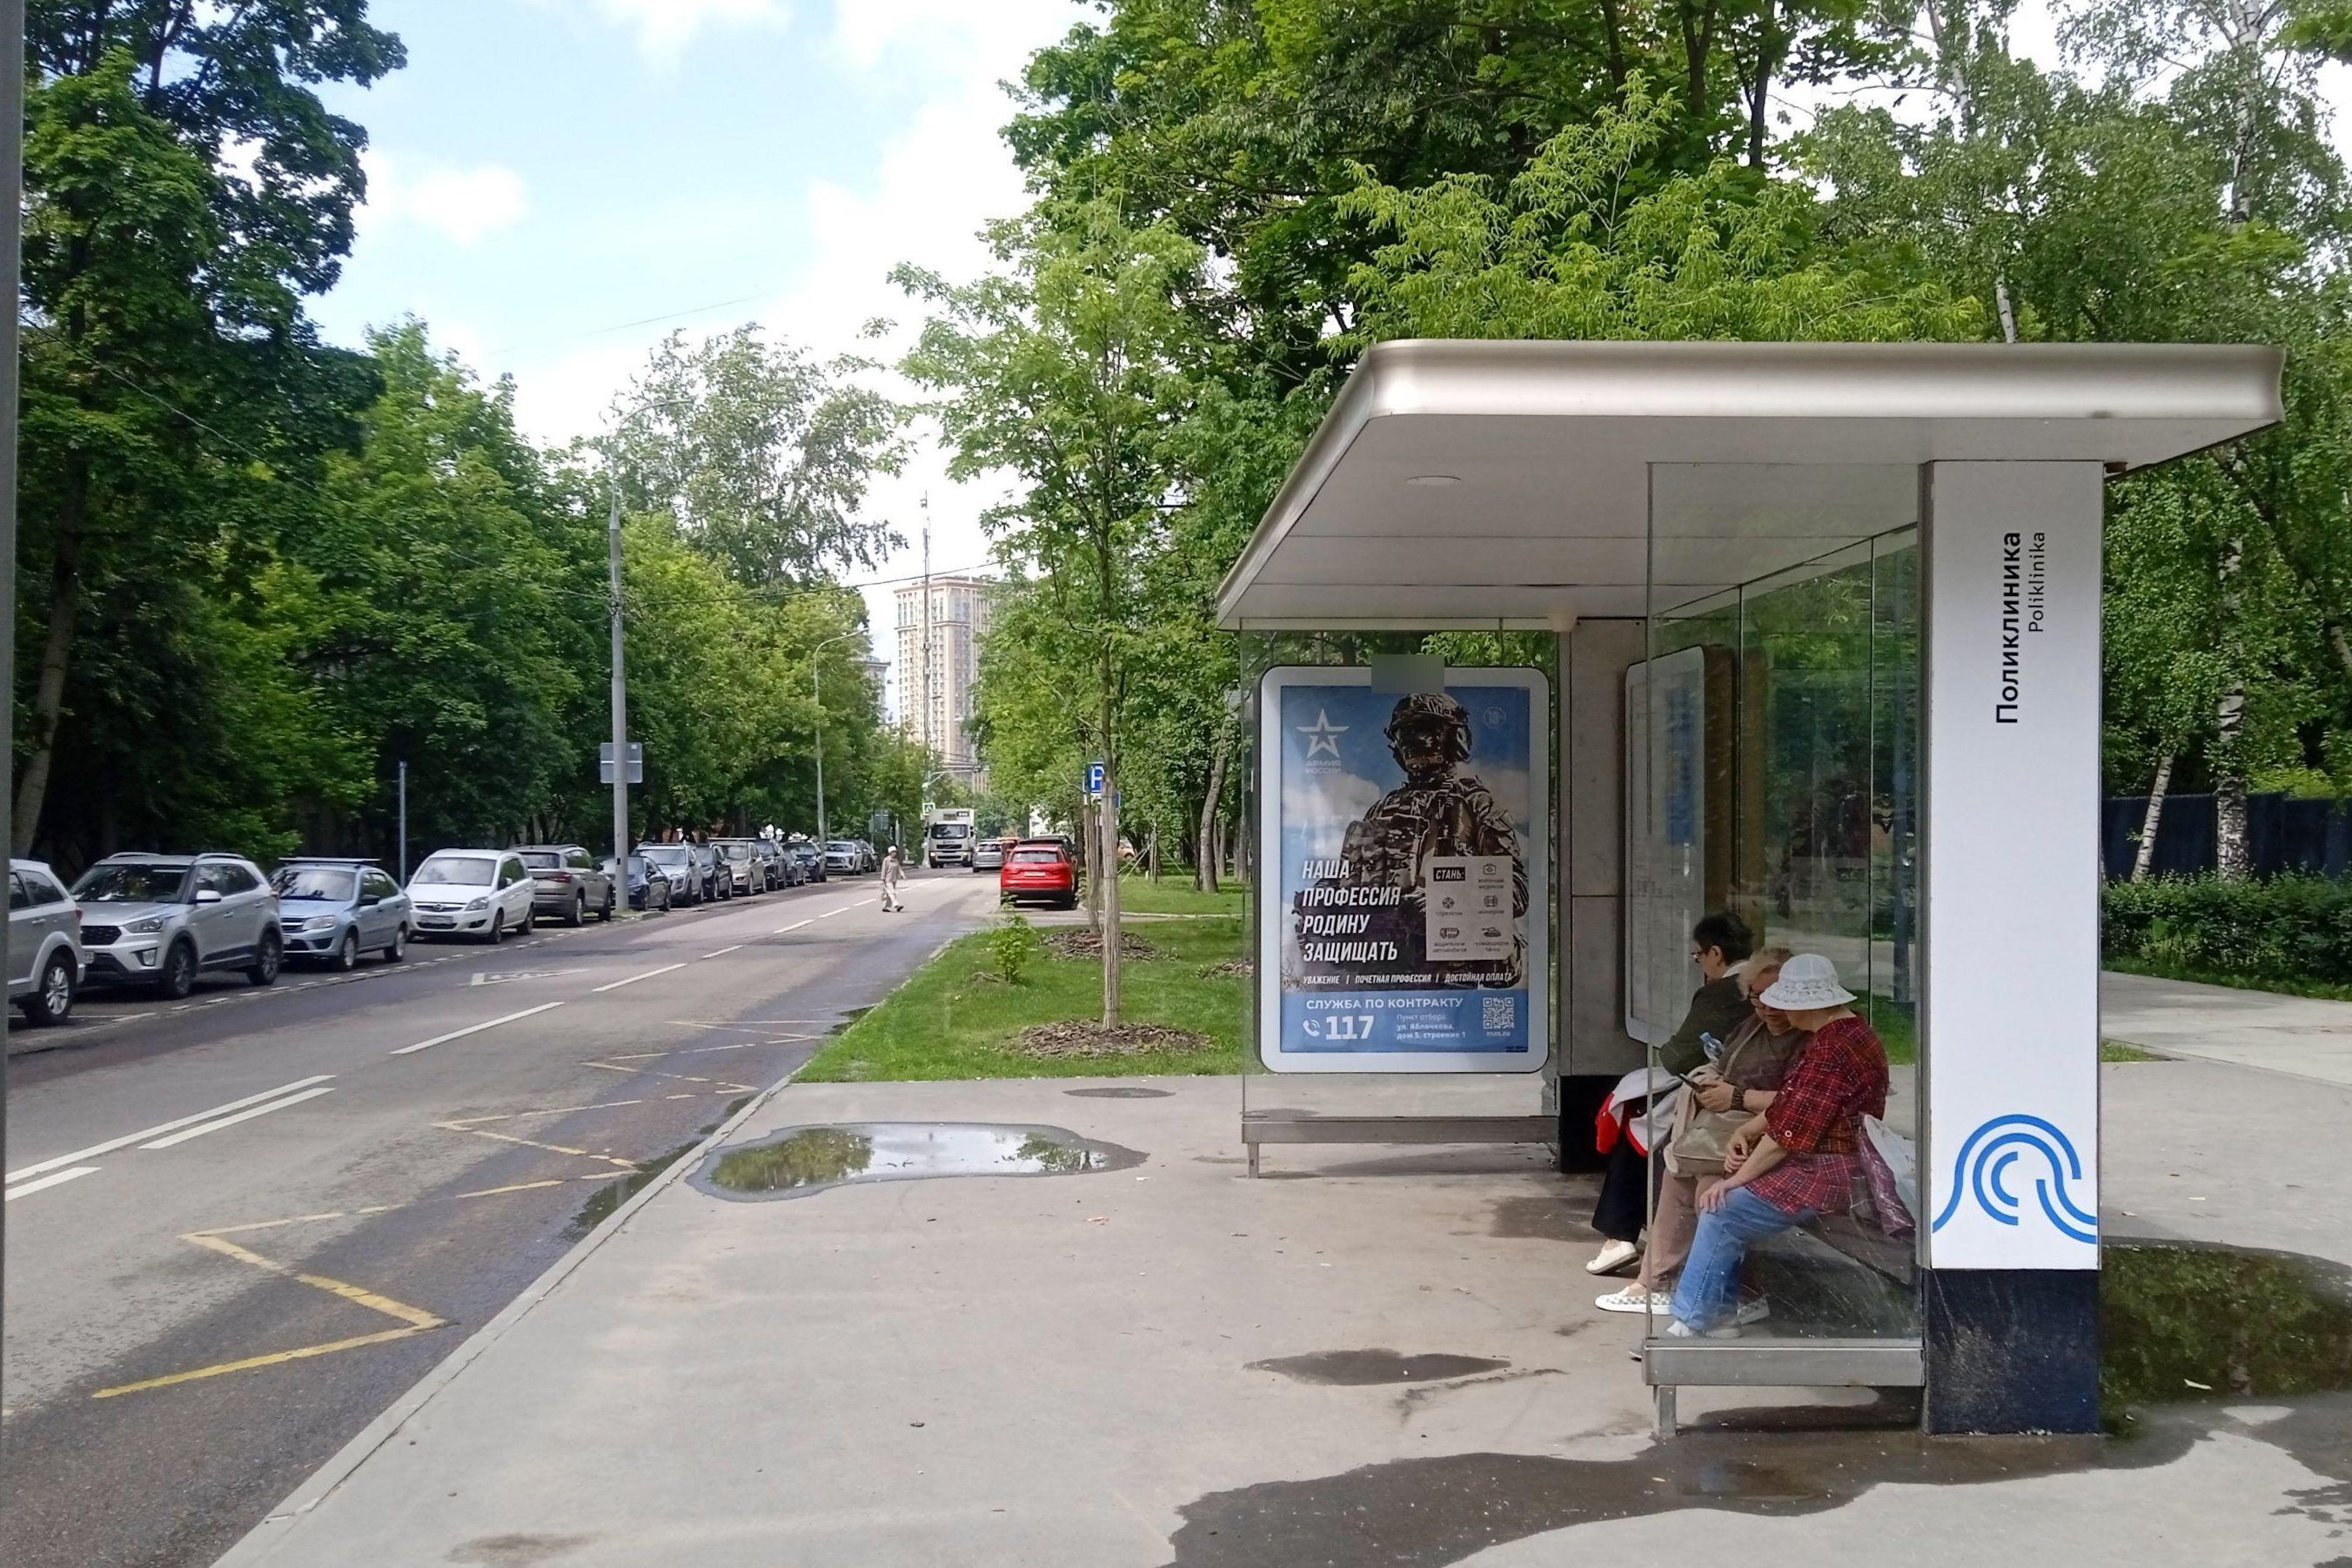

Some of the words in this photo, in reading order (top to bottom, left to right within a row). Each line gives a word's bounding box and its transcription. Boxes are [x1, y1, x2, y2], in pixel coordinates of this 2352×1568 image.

[2028, 533, 2045, 632] Poliklinika
[1996, 533, 2020, 723] Поликлиника
[1091, 766, 1105, 788] P
[1302, 860, 1350, 879] НАША
[1435, 869, 1464, 881] СТАНЬ:
[1302, 887, 1401, 907] ПРОФЕССИЯ
[1303, 915, 1370, 936] РОДИНУ
[1303, 941, 1398, 963] ЗАЩИЩАТЬ
[1303, 975, 1340, 984] УВАЖЕНИЕ
[1355, 975, 1390, 984] ПОЧЕТНАЯ
[1390, 974, 1432, 983] ПРОФЕССИЯ
[1444, 973, 1484, 982] ДОСТОЙНАЯ
[1485, 972, 1512, 982] ОПЛАТА
[1306, 998, 1361, 1009] СЛУЖБА
[1365, 999, 1384, 1008] ПО
[1388, 998, 1464, 1008] КОНТРАКТУ
[1325, 1015, 1375, 1040] 117
